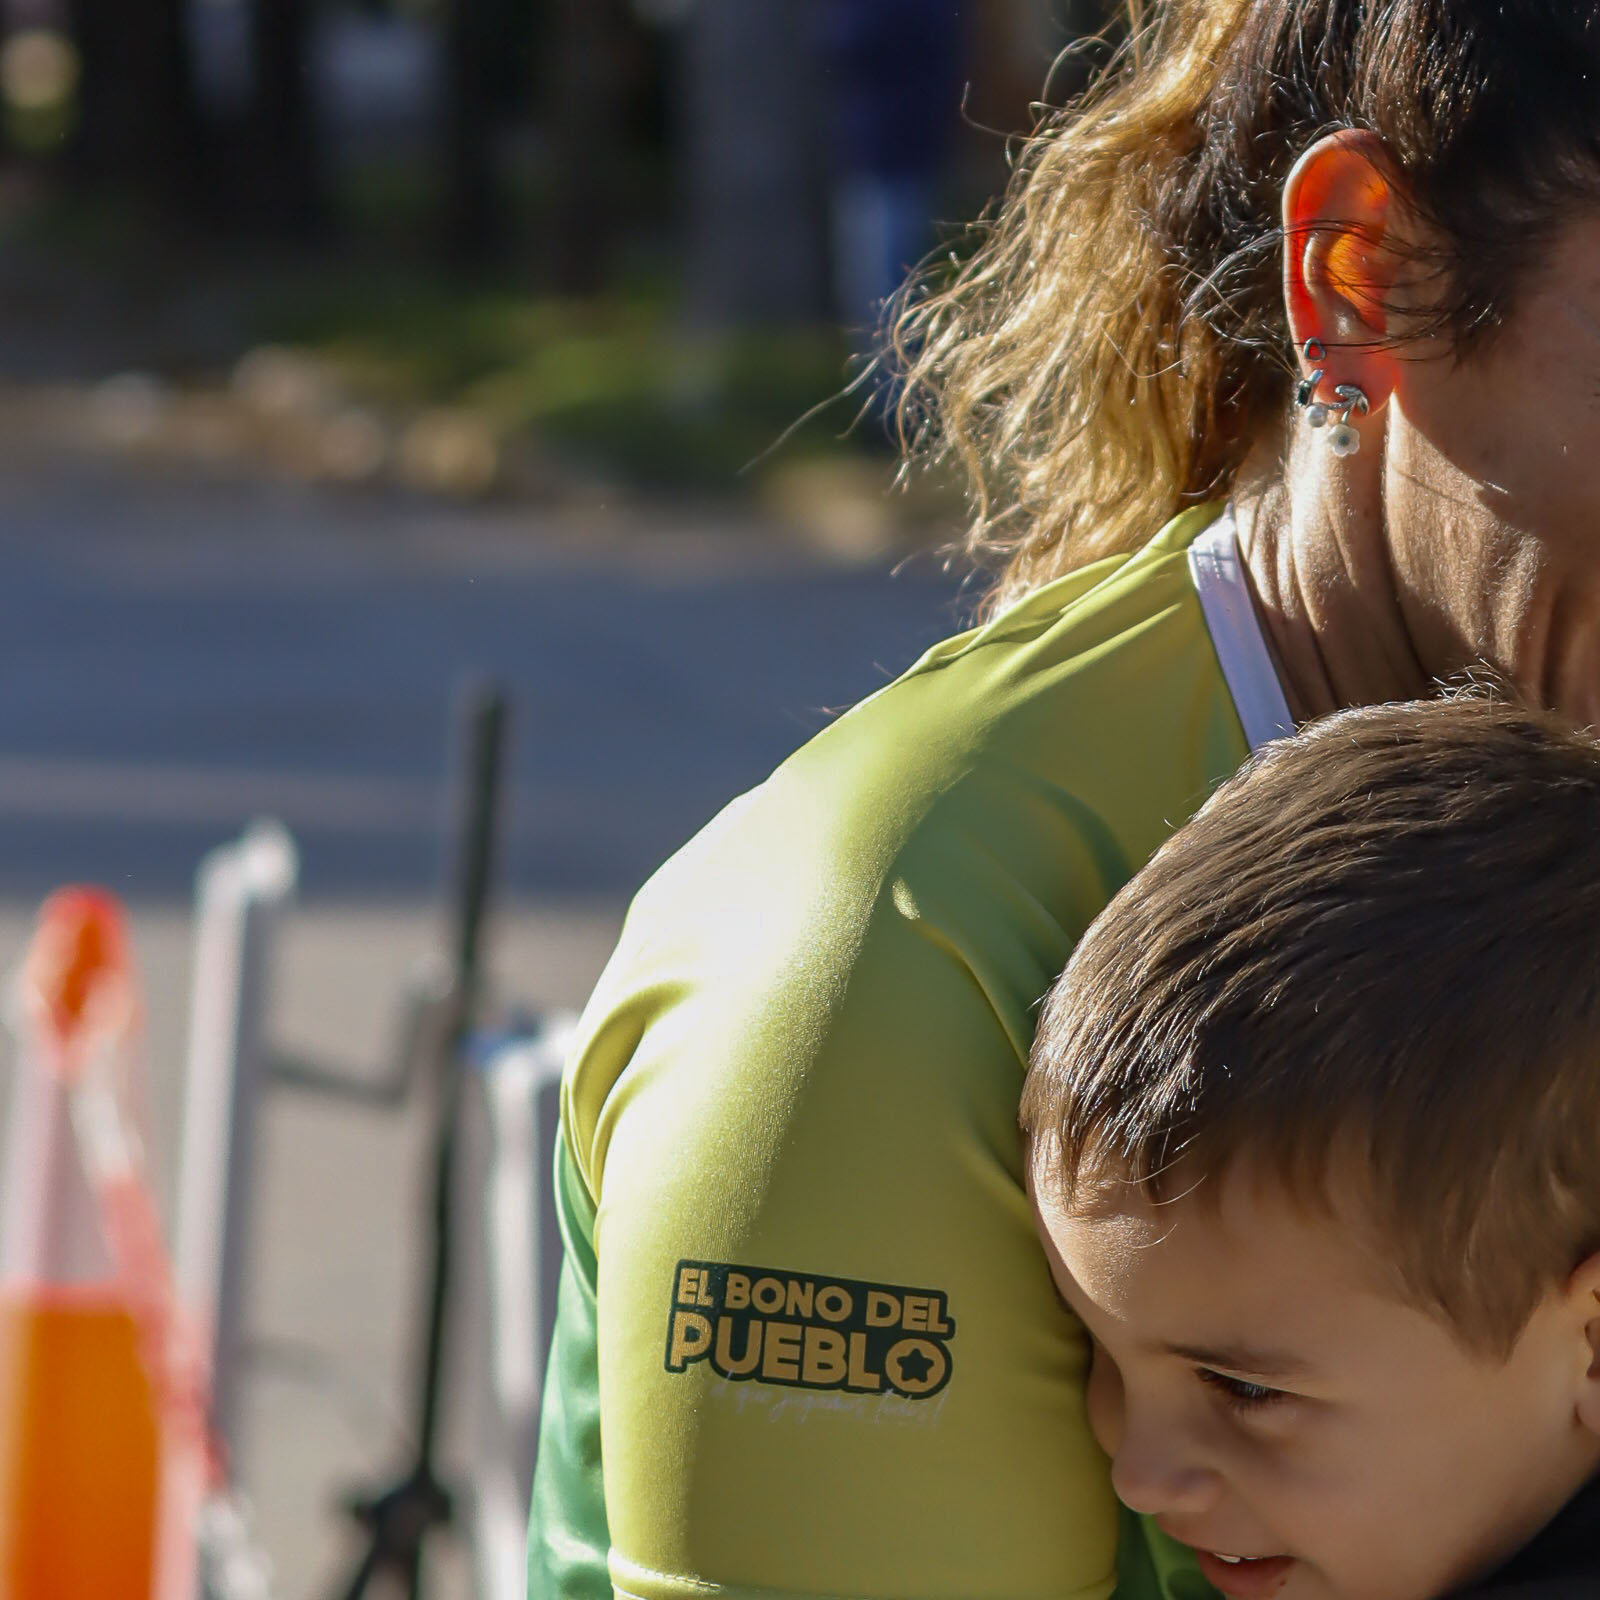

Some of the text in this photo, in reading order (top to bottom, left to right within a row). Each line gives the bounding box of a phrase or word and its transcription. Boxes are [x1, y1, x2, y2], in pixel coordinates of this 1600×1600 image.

[677, 1267, 949, 1334] EL BONO DEL
[670, 1310, 946, 1393] PUEBLO
